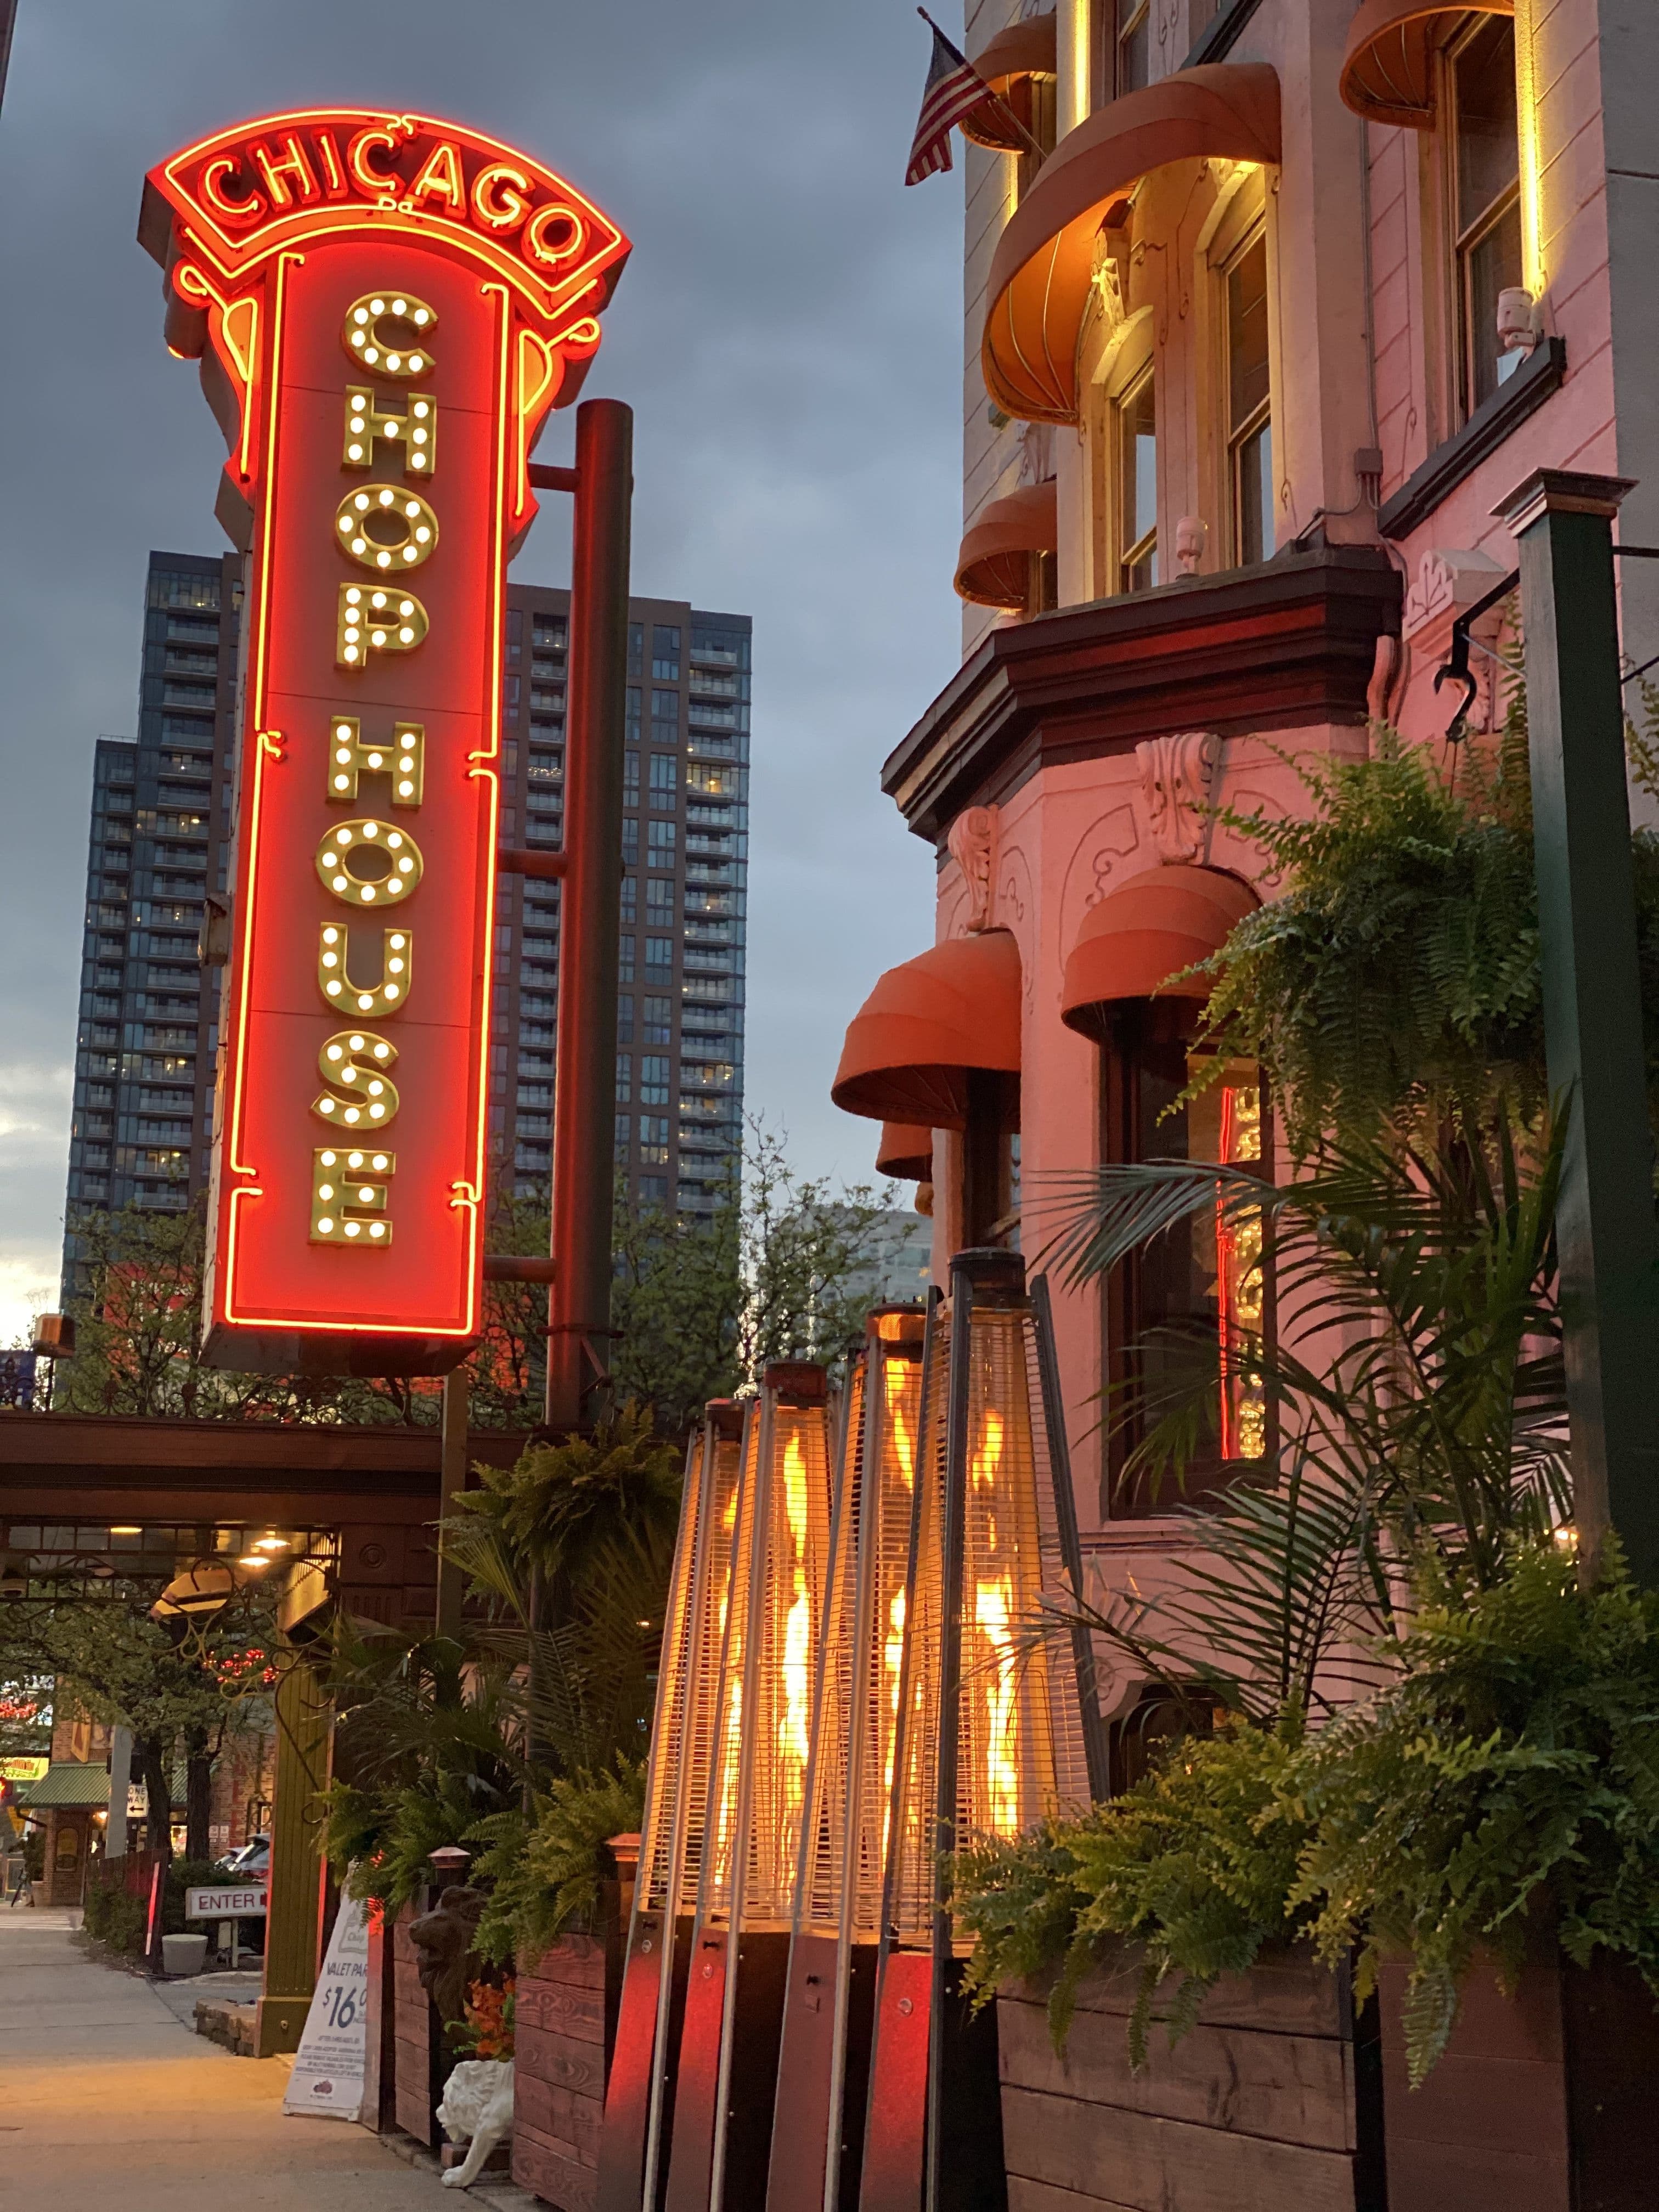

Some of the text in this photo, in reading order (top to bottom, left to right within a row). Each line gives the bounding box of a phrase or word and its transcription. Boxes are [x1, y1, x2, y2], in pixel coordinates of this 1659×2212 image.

[196, 125, 590, 272] CHICAGO
[199, 1894, 255, 1910] ENTER
[327, 1962, 352, 1976] VALET
